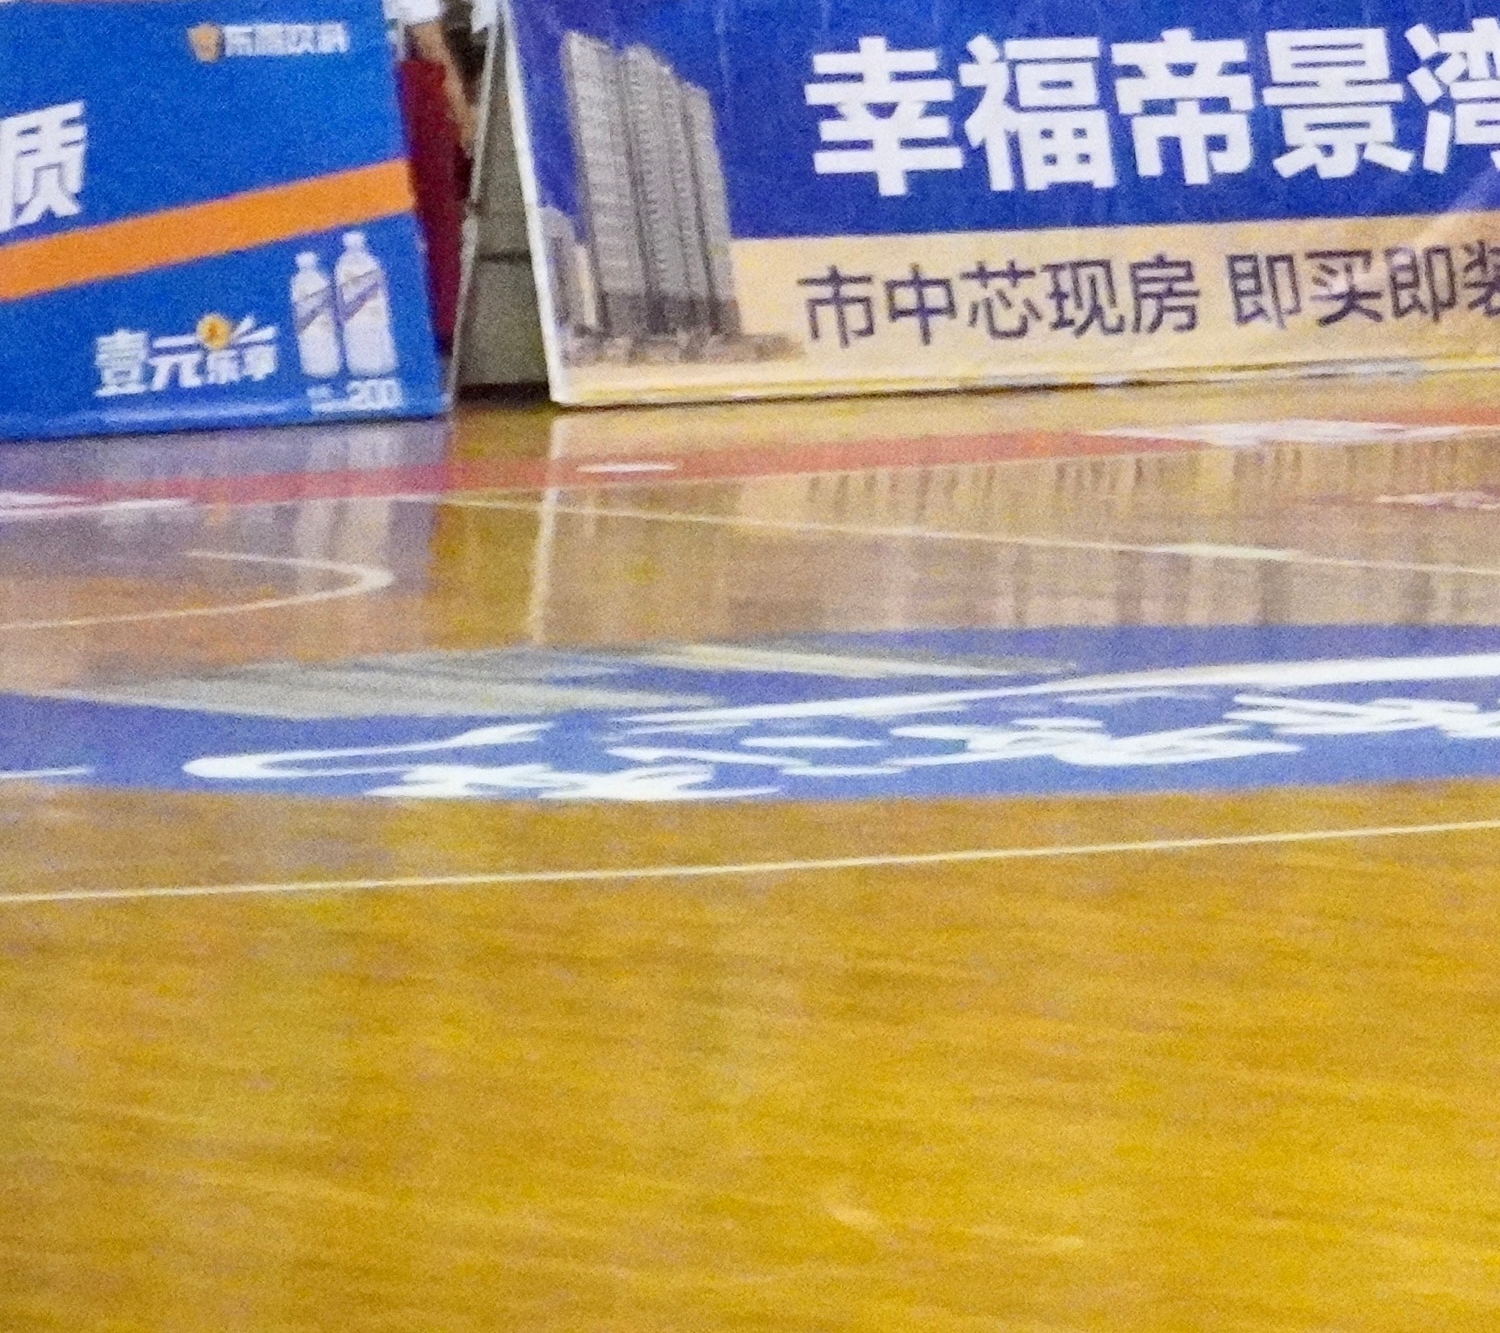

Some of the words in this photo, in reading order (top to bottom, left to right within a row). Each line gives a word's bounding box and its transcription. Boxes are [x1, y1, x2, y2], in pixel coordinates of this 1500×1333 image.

[797, 254, 1200, 350] 市中芯现房
